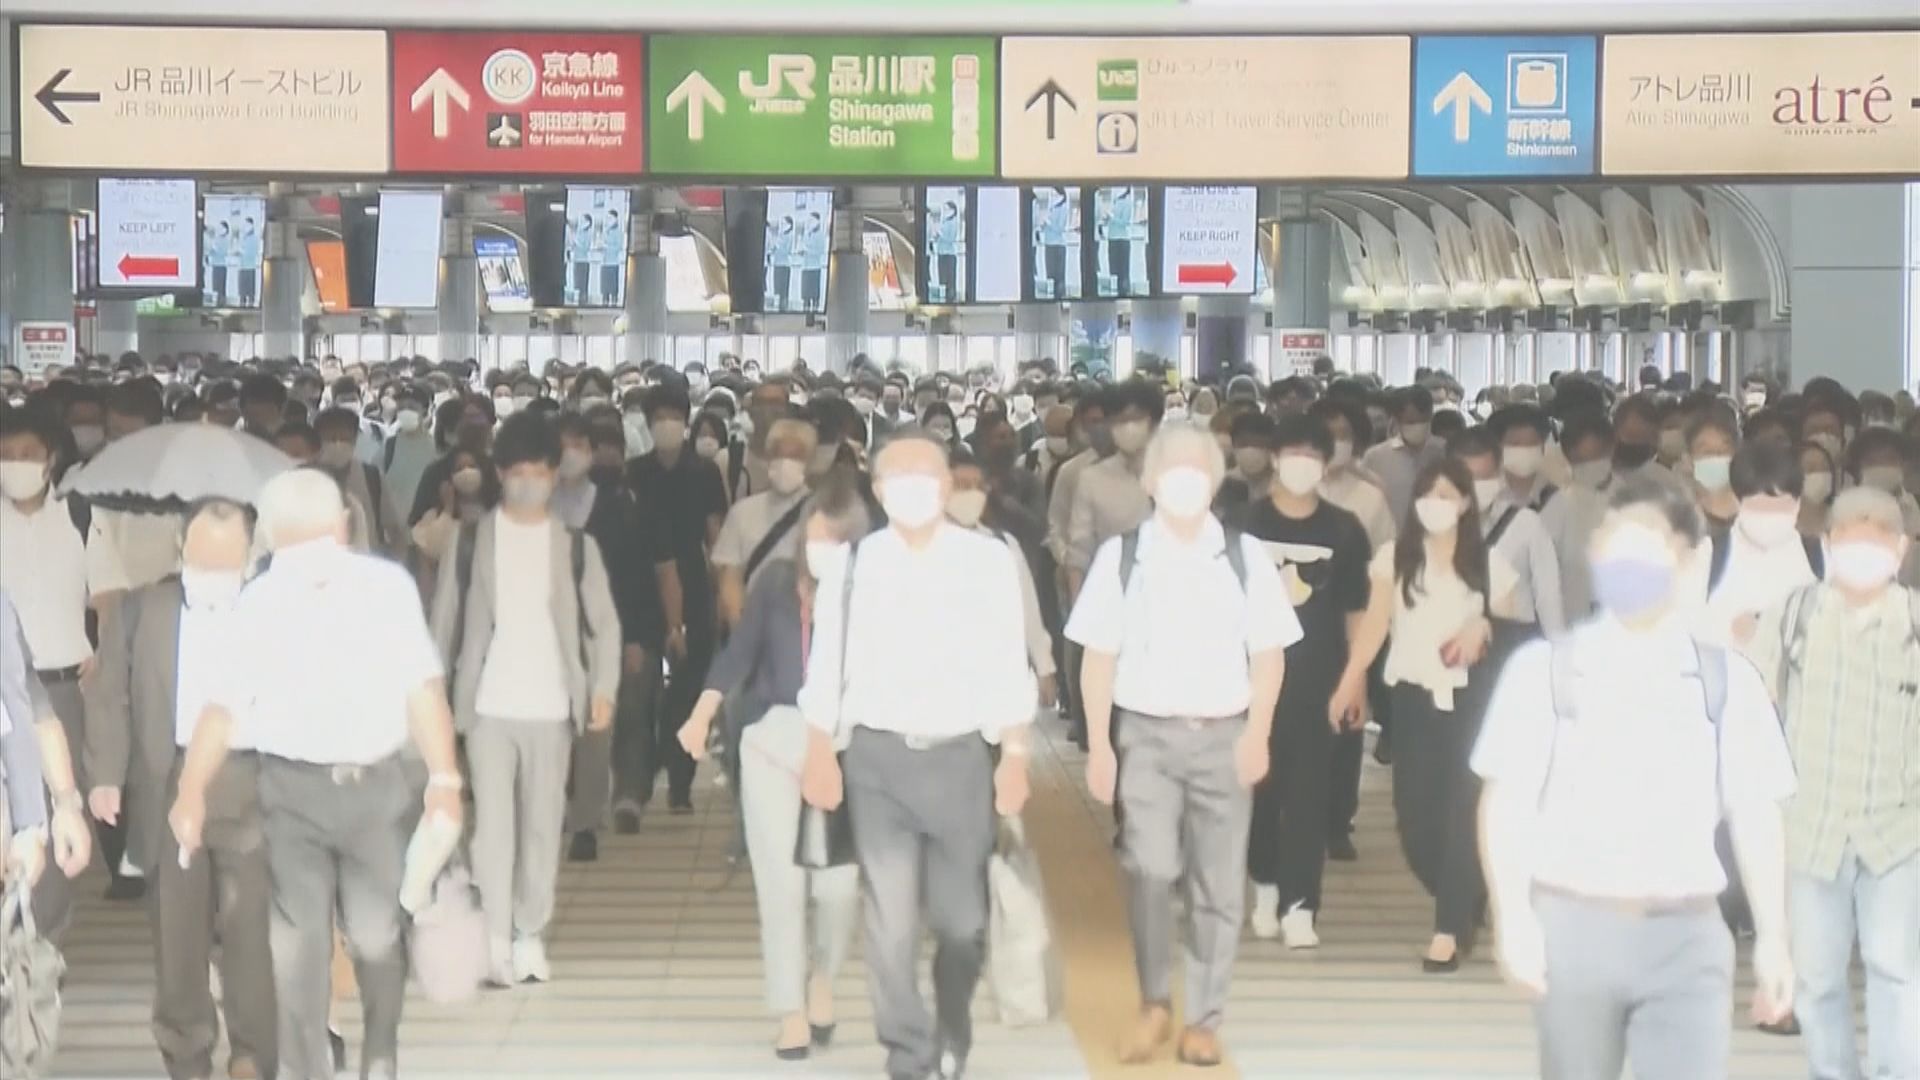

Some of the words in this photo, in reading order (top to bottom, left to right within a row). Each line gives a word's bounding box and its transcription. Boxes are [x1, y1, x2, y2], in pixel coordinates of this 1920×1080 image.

[542, 51, 619, 79] 京急線
[738, 54, 817, 98] JR
[829, 55, 936, 95] 品川駅
[114, 67, 152, 93] JR
[160, 66, 363, 97] 品川イーストビル
[593, 81, 625, 98] Line
[1629, 72, 1752, 104] アトレ品川
[114, 101, 138, 119] JR
[144, 100, 241, 121] Shinagawa
[246, 101, 284, 119] East
[290, 101, 359, 121] Building
[1771, 73, 1894, 126] atré
[529, 111, 627, 132] 羽田空港方面
[829, 98, 934, 125] Shinagawa
[1274, 108, 1335, 129] Service
[1337, 106, 1393, 129] Center
[1662, 108, 1751, 130] Shinagawa
[529, 134, 544, 146] for
[545, 133, 587, 146] Haneda
[588, 133, 623, 148] Airport
[829, 123, 896, 148] Station
[1506, 142, 1578, 157] Shinkansen
[119, 222, 148, 234] KEEP
[149, 222, 177, 234] LEFT
[1179, 230, 1208, 242] KEEP
[1208, 230, 1241, 242] RIGHT
